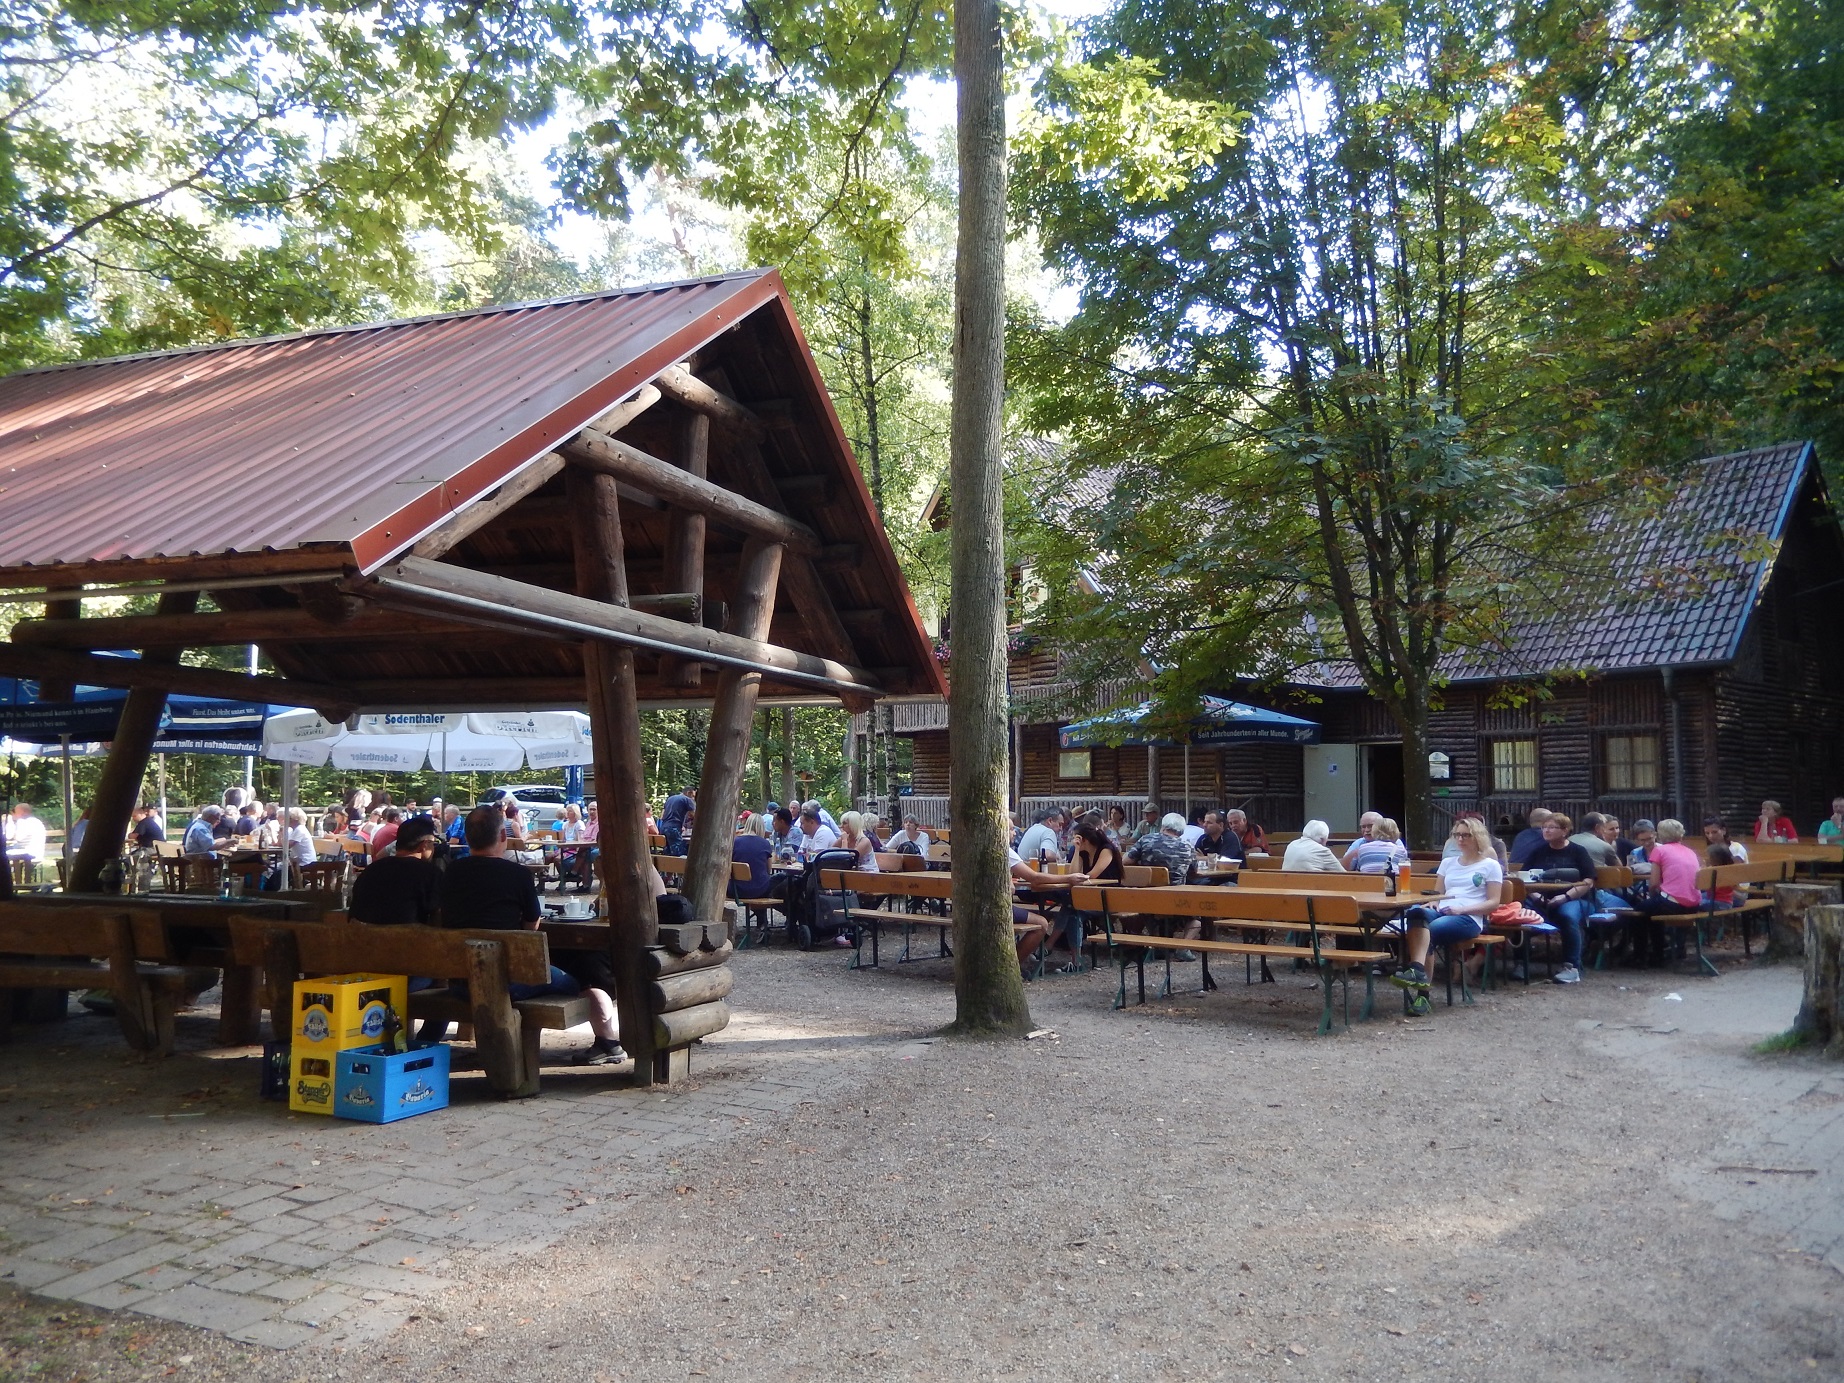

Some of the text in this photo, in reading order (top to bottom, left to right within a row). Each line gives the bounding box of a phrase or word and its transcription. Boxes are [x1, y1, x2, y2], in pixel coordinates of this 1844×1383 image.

[385, 714, 445, 725] Sodenthaler
[1198, 730, 1210, 739] Seit
[1258, 729, 1270, 737] aller
